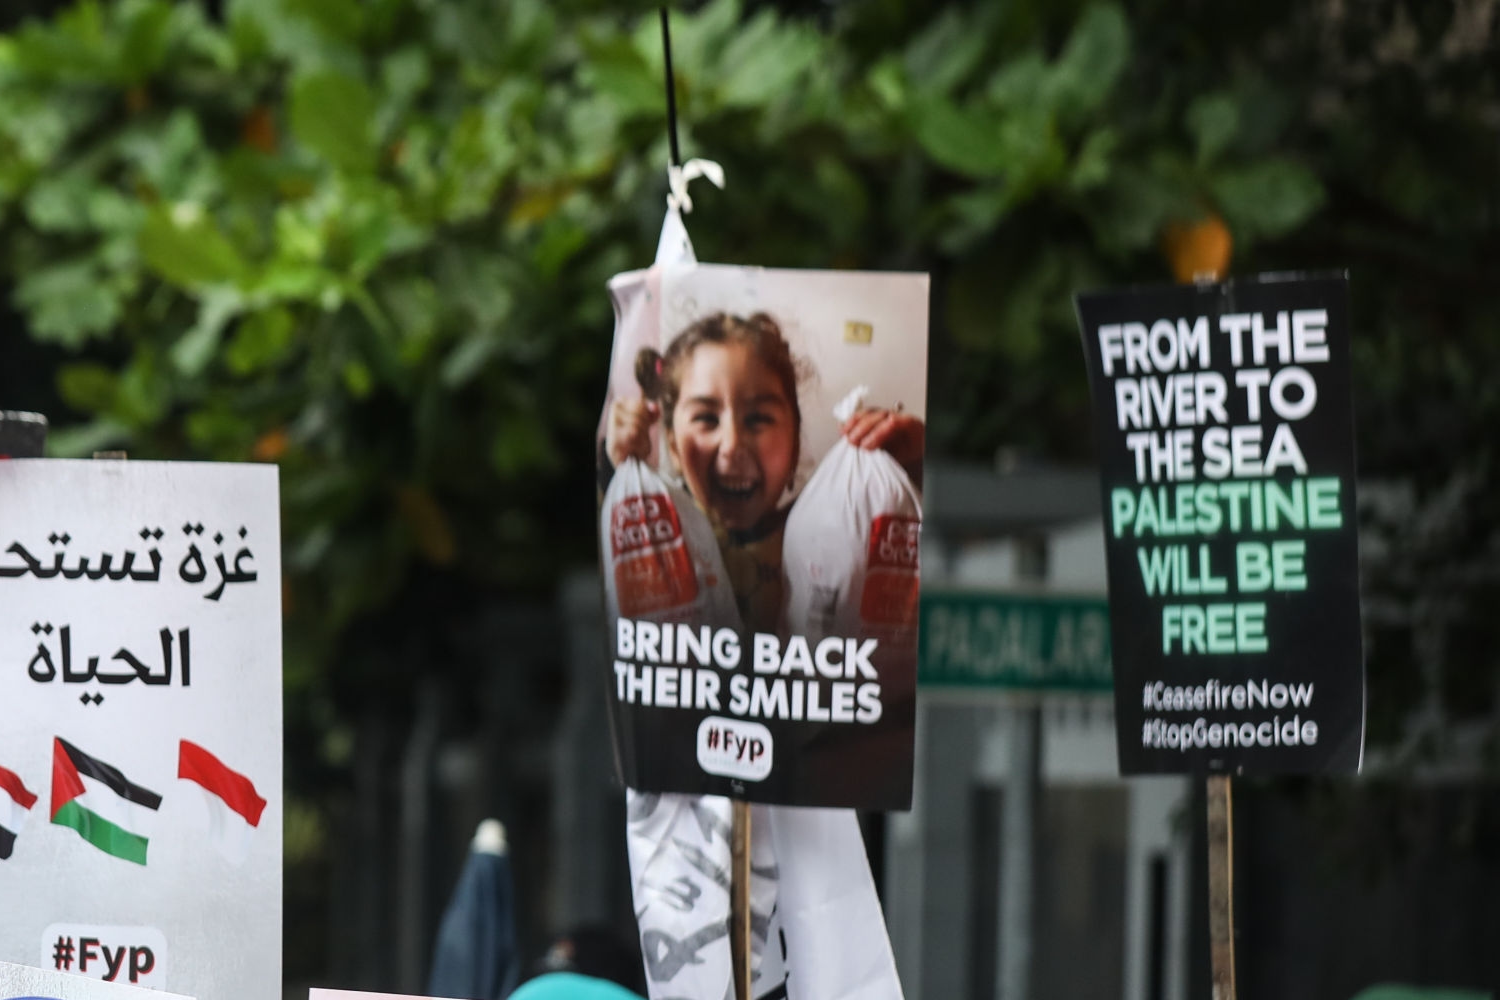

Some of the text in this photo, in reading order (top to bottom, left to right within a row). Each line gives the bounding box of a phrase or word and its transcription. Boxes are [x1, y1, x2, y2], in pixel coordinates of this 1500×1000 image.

[1099, 309, 1330, 376] FROM THE
[1115, 367, 1318, 432] RIVER TO
[1126, 423, 1308, 482] THE SEA
[1111, 477, 1344, 538] PALESTINE
[179, 524, 258, 601] غزة
[1137, 540, 1309, 597] WILL BE
[616, 617, 879, 679] BRING BACK
[1162, 602, 1269, 655] FREE
[28, 622, 190, 705] الحياة
[614, 660, 883, 724] THEIR SMILES
[1143, 680, 1314, 711] #CeasefireNow
[707, 727, 765, 763] #Fyp
[1142, 715, 1319, 751] #StopGenocide
[52, 935, 155, 983] #Fyp
